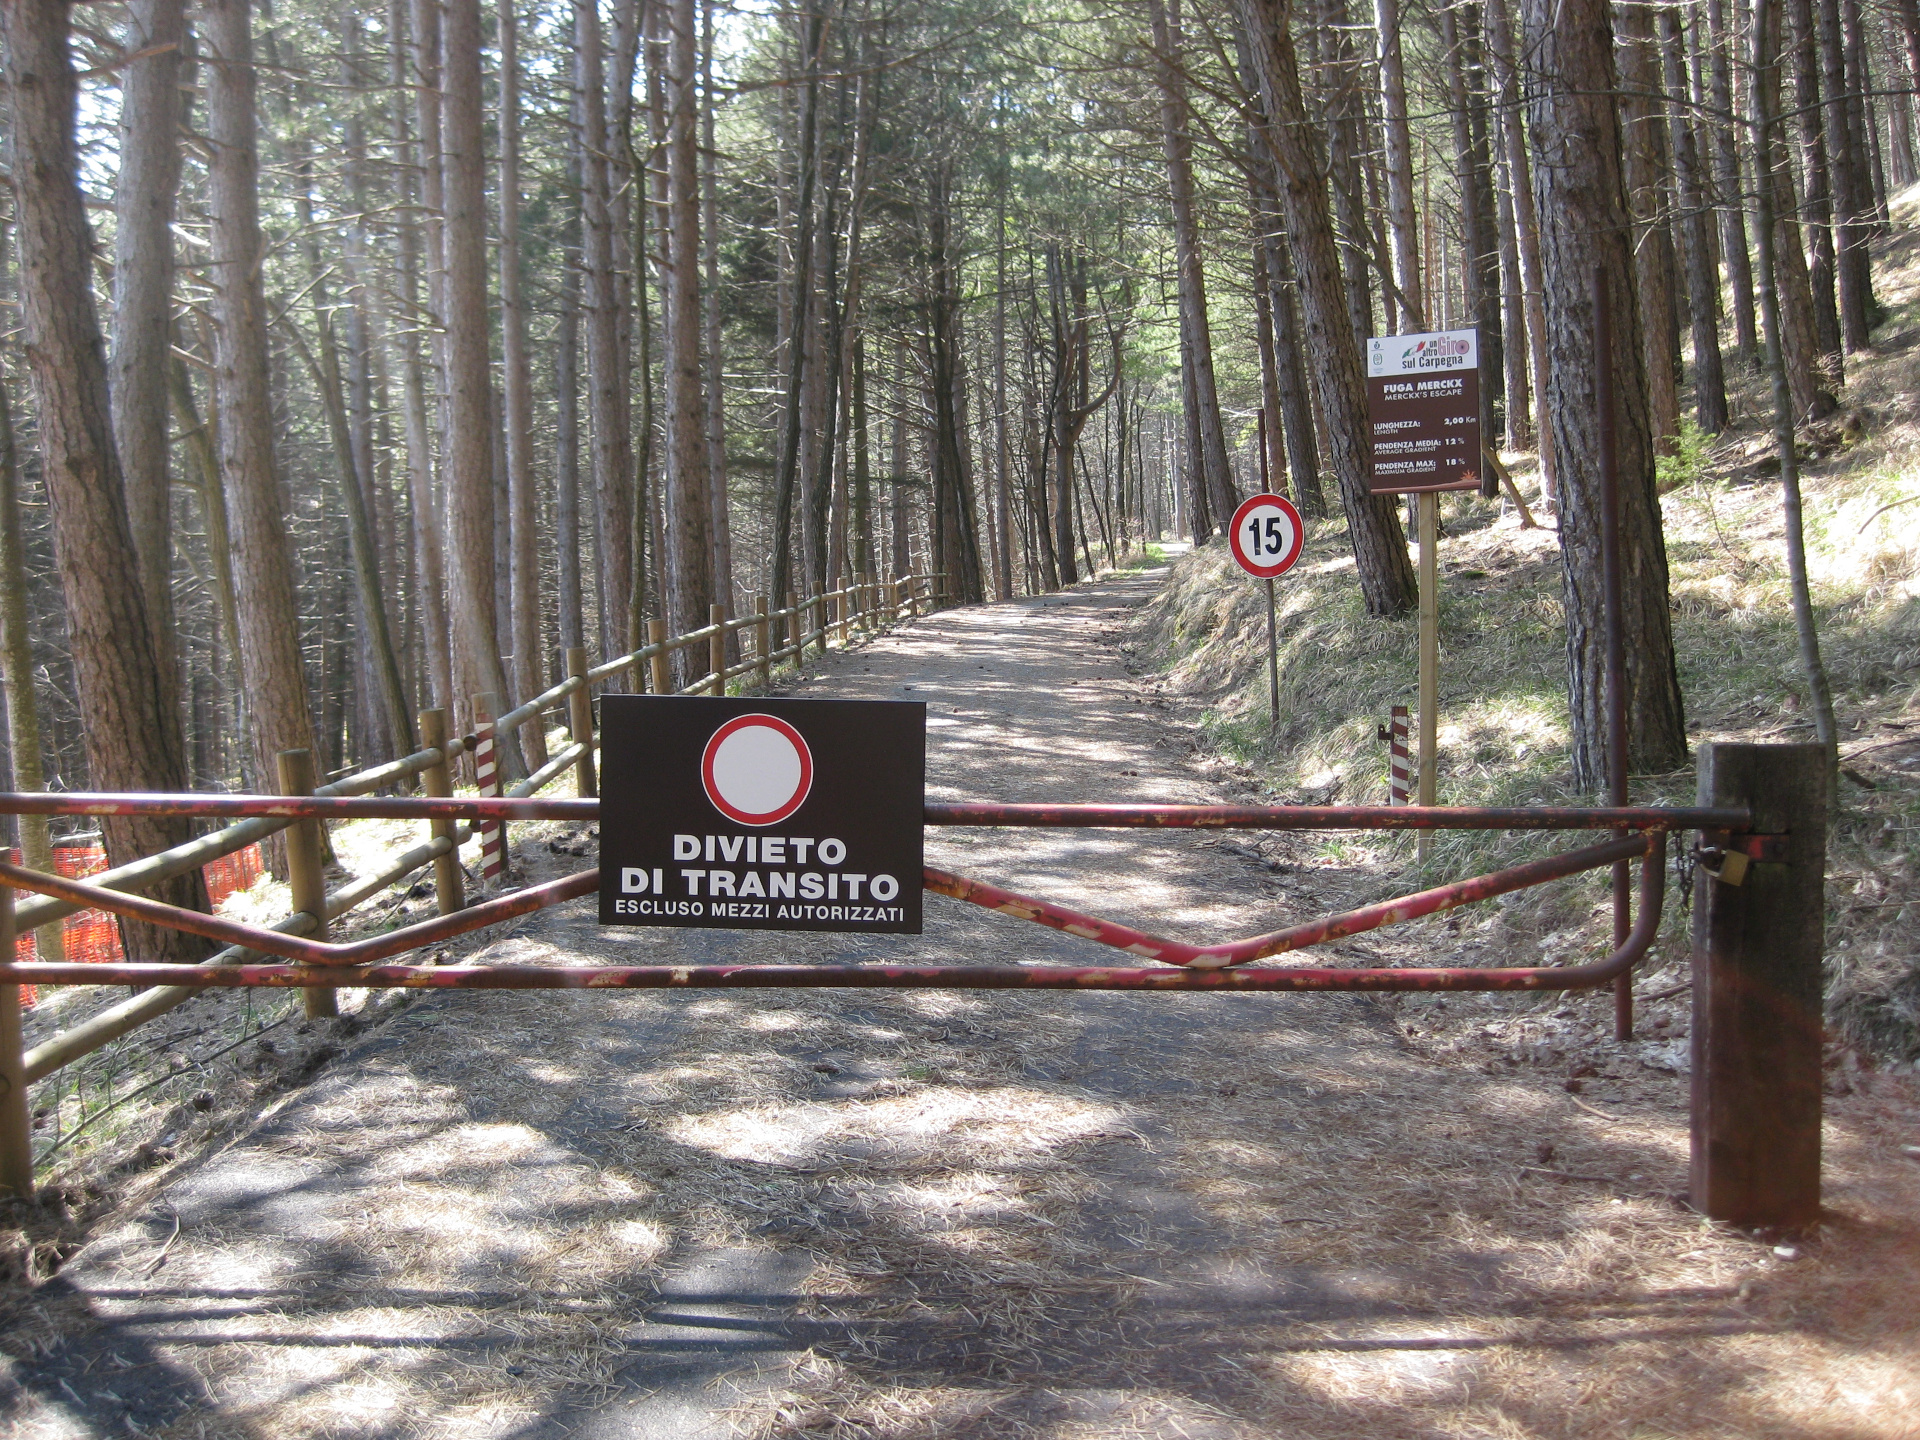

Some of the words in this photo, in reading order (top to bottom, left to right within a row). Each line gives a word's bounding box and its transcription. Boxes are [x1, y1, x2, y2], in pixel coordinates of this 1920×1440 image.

[1423, 348, 1437, 357] altro
[1402, 358, 1415, 369] sul
[1419, 355, 1463, 368] Carpegna
[1384, 383, 1413, 393] FUGA
[1417, 379, 1462, 390] MERCKX
[1385, 391, 1427, 401] MERCKX'S
[1430, 389, 1462, 397] ESCAPE
[1374, 421, 1420, 429] LUNGHEZZA:
[1444, 417, 1464, 426] 2,00
[1375, 441, 1413, 450] PENDENZA
[1375, 461, 1413, 470] PENDENZA
[1249, 517, 1282, 555] 15
[673, 834, 846, 865] DIVIETO
[621, 868, 663, 894] DI
[681, 869, 899, 901] TRANSITO
[615, 900, 703, 916] ESCLUSO
[711, 902, 769, 918] MEZZI
[777, 905, 904, 921] AUTORIZZATI
